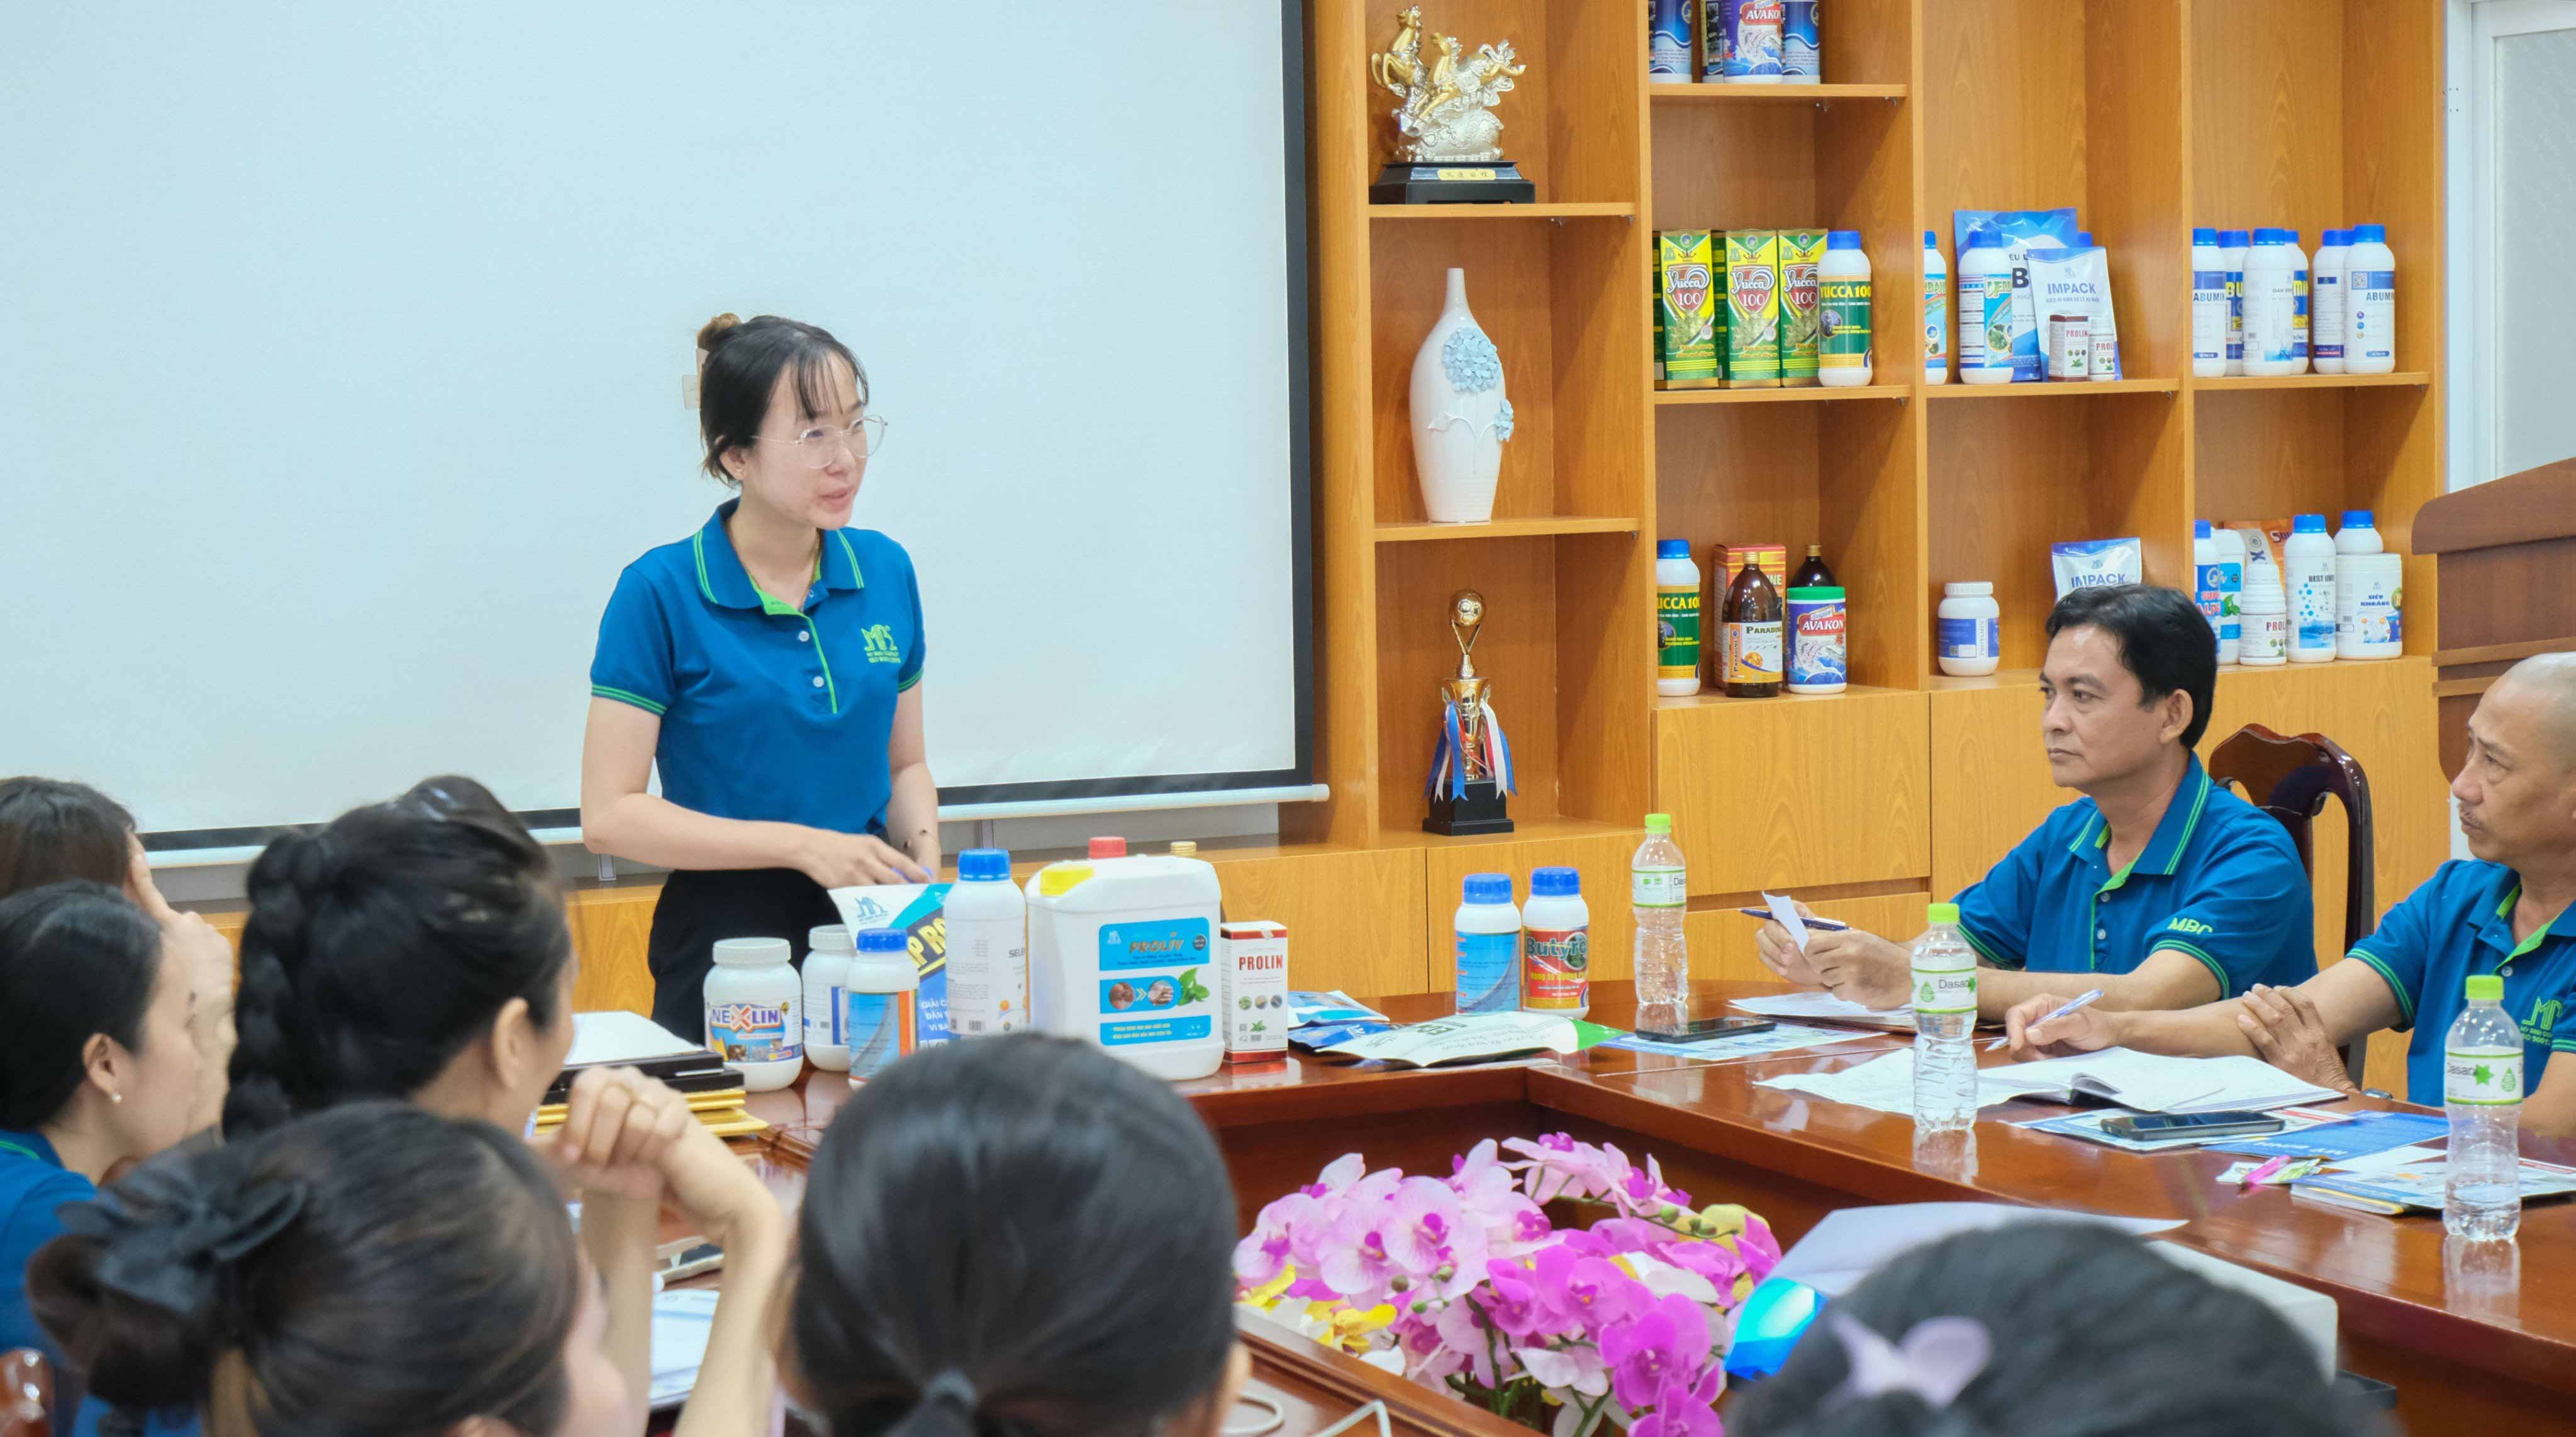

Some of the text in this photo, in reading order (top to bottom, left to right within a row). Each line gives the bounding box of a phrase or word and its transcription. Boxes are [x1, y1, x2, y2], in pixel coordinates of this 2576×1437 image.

[1666, 268, 1703, 294] Yucca
[1731, 269, 1768, 294] Yucca
[2048, 282, 2096, 294] IMPACK
[1678, 292, 1702, 305] 100
[1743, 293, 1766, 306] 100
[1795, 292, 1817, 305] 100
[2066, 329, 2088, 338] PROLIN
[2071, 573, 2126, 588] IMPACK
[1802, 619, 1843, 630] AVAKON
[1239, 955, 1283, 970] PROLIN
[712, 1006, 779, 1030] NEXLIN
